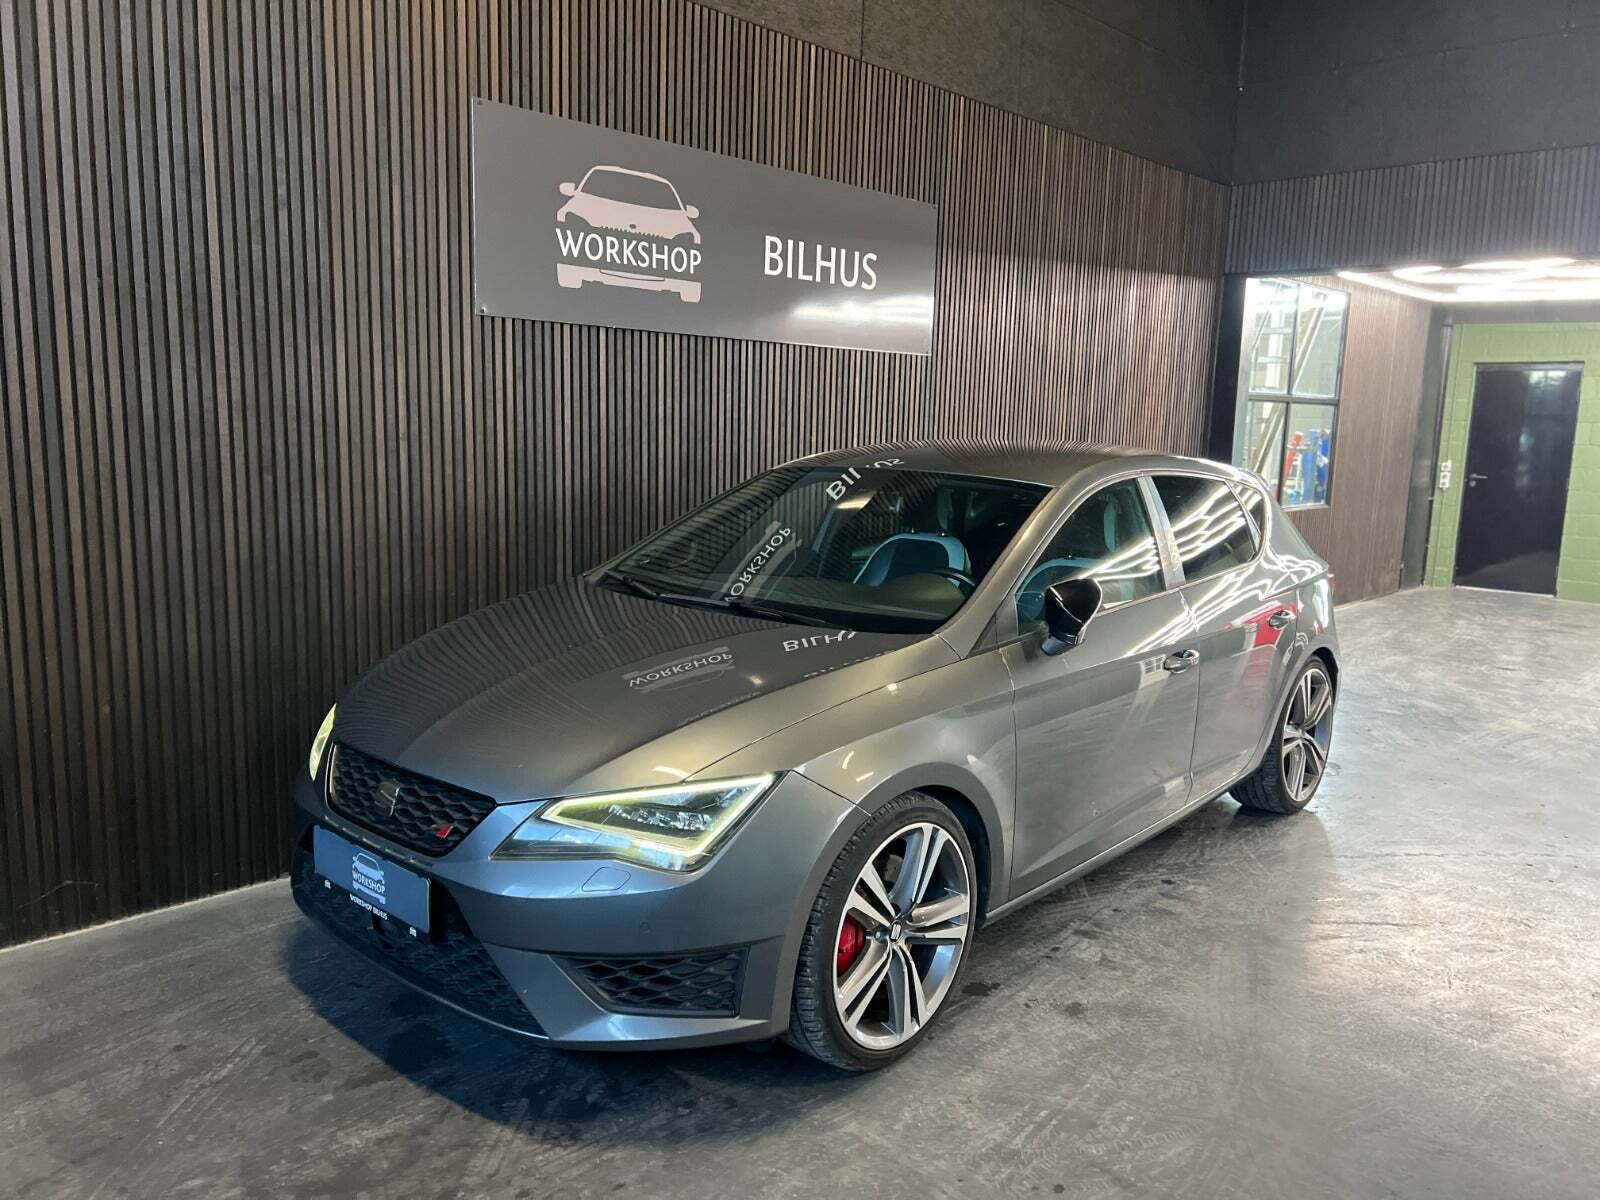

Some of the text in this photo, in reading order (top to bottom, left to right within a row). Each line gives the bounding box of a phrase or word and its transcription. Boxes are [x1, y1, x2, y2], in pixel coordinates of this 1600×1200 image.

[555, 228, 877, 290] WORKSHOP BILHUS
[352, 870, 385, 894] WORKSHOP
